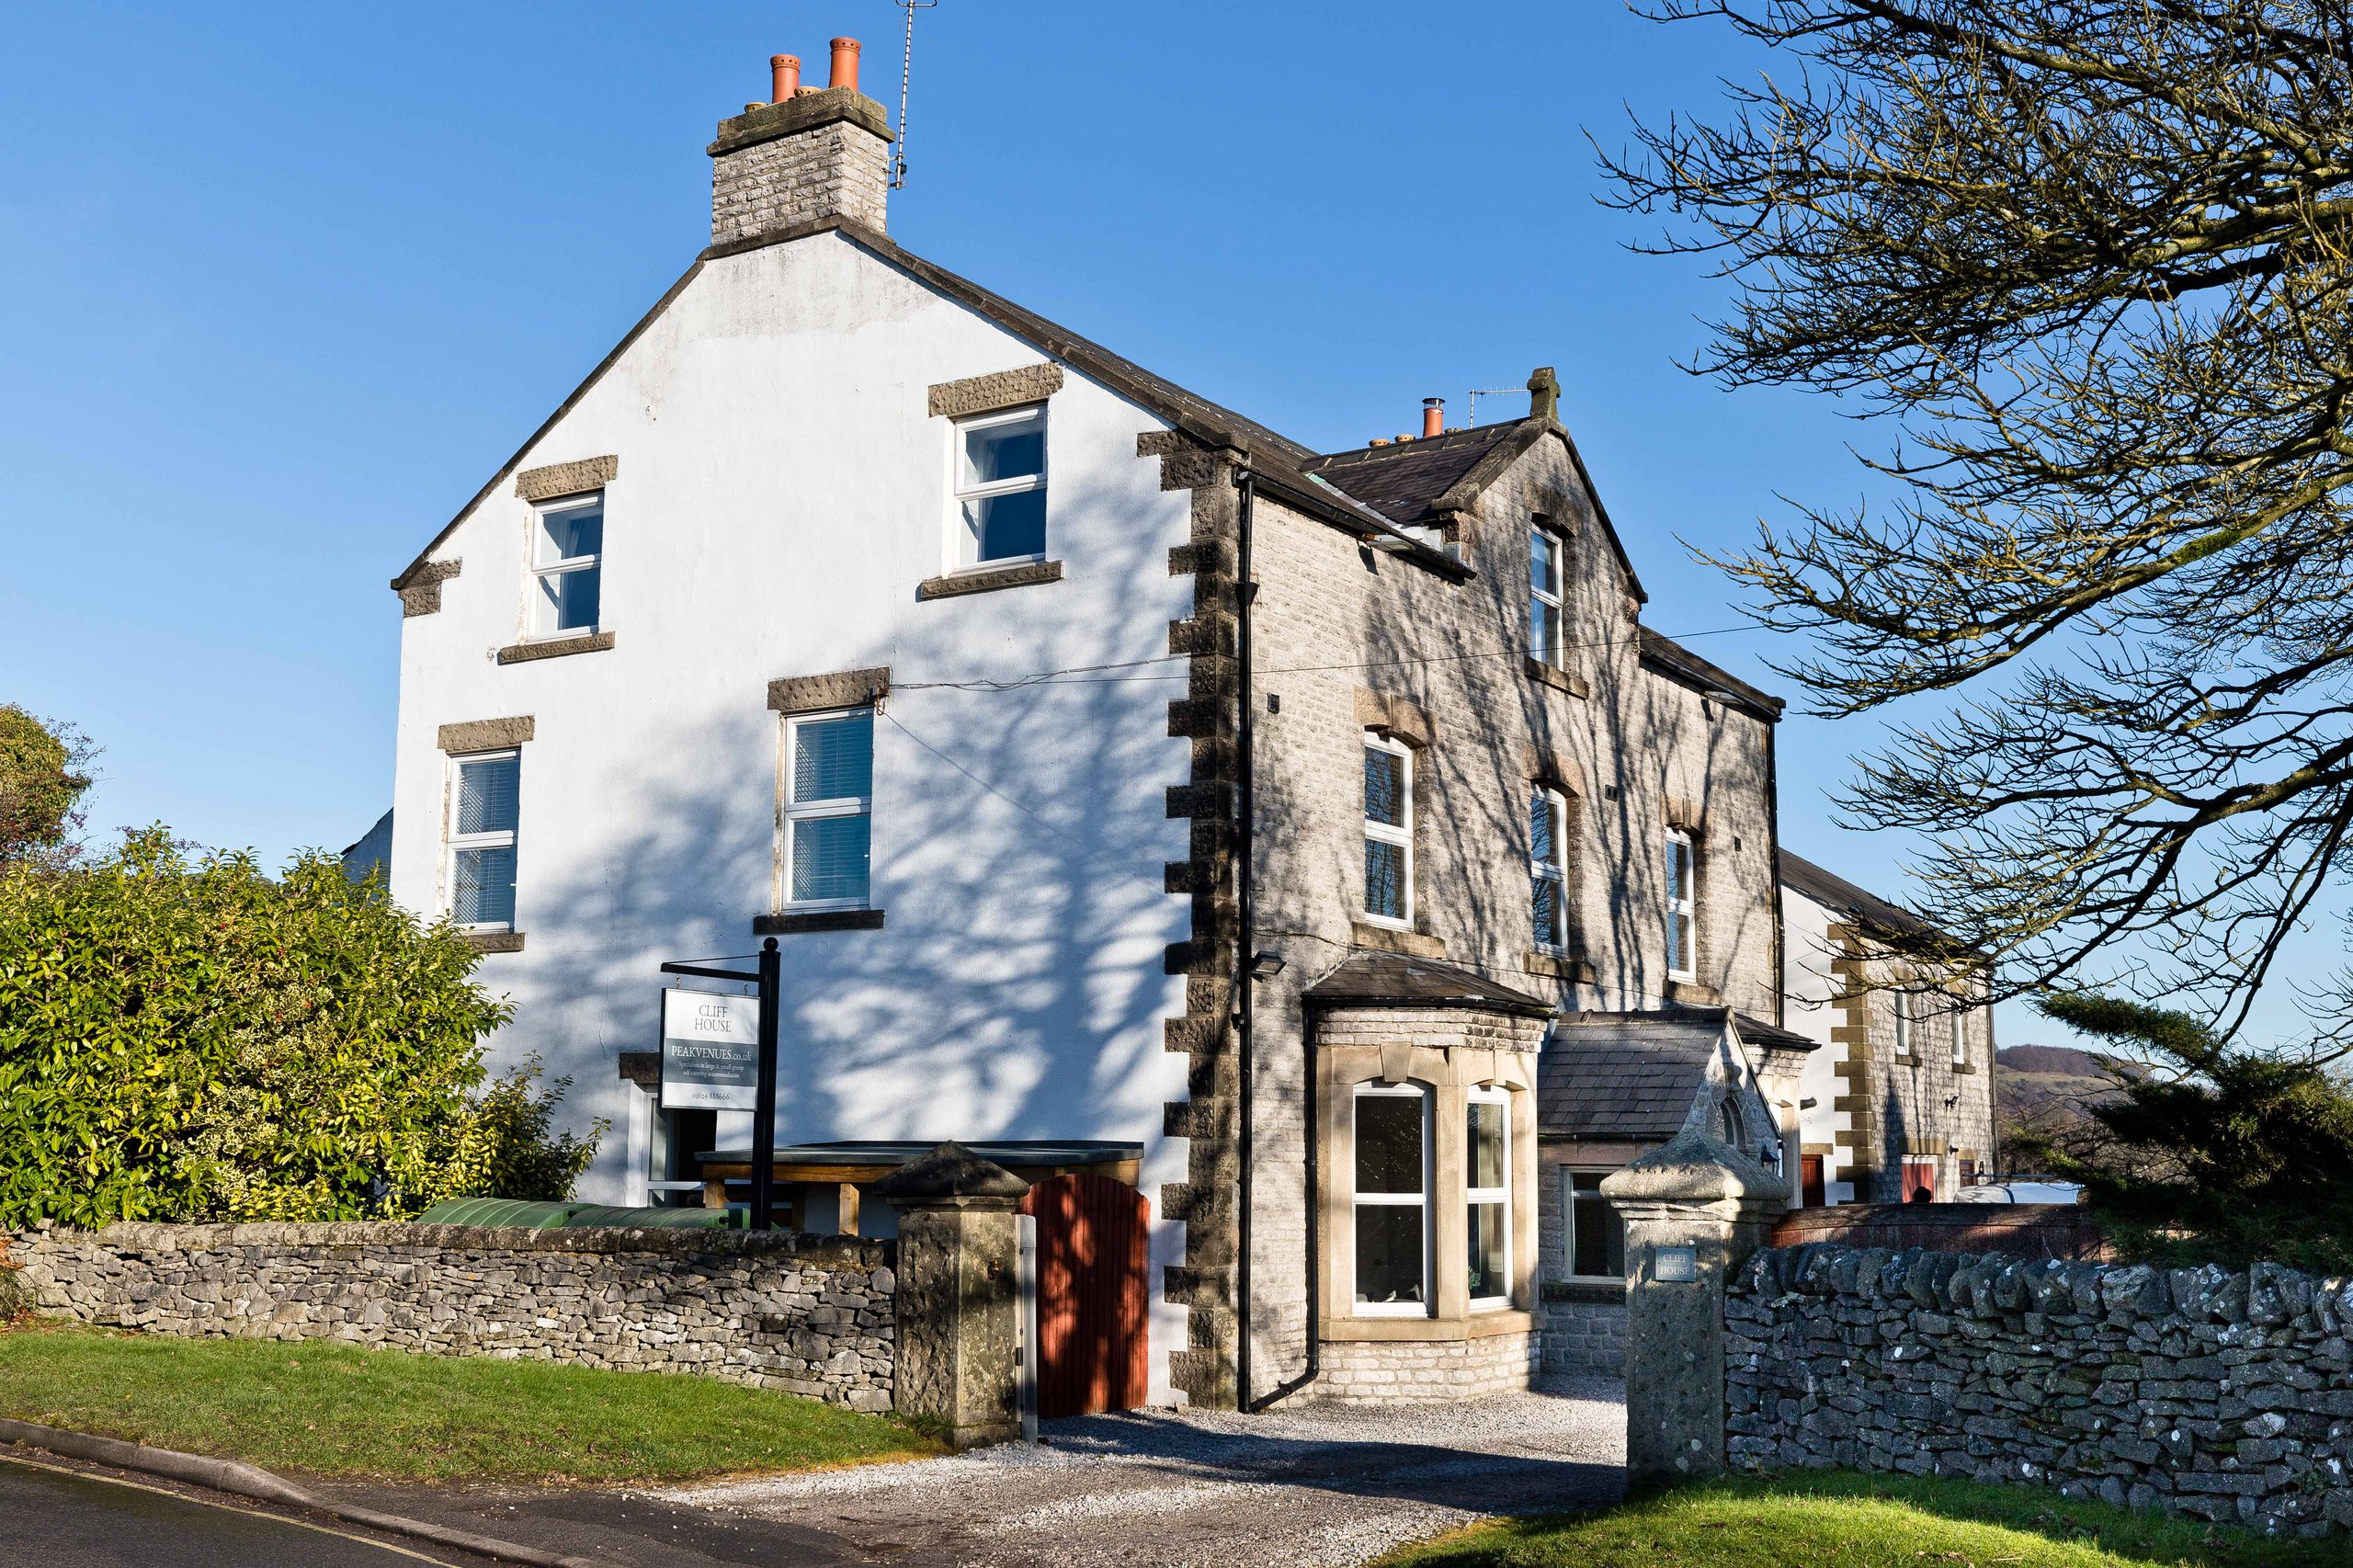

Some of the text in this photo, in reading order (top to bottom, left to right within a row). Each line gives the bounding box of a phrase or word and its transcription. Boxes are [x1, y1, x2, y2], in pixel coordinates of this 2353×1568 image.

[699, 1005, 728, 1017] CLIFF
[695, 1018, 732, 1032] HOUSE
[671, 1045, 752, 1062] PEAKVENUES.co.uk
[692, 1092, 729, 1101] 01629 888666
[1663, 1254, 1688, 1262] CLIFF
[1660, 1267, 1690, 1275] HOUSE
